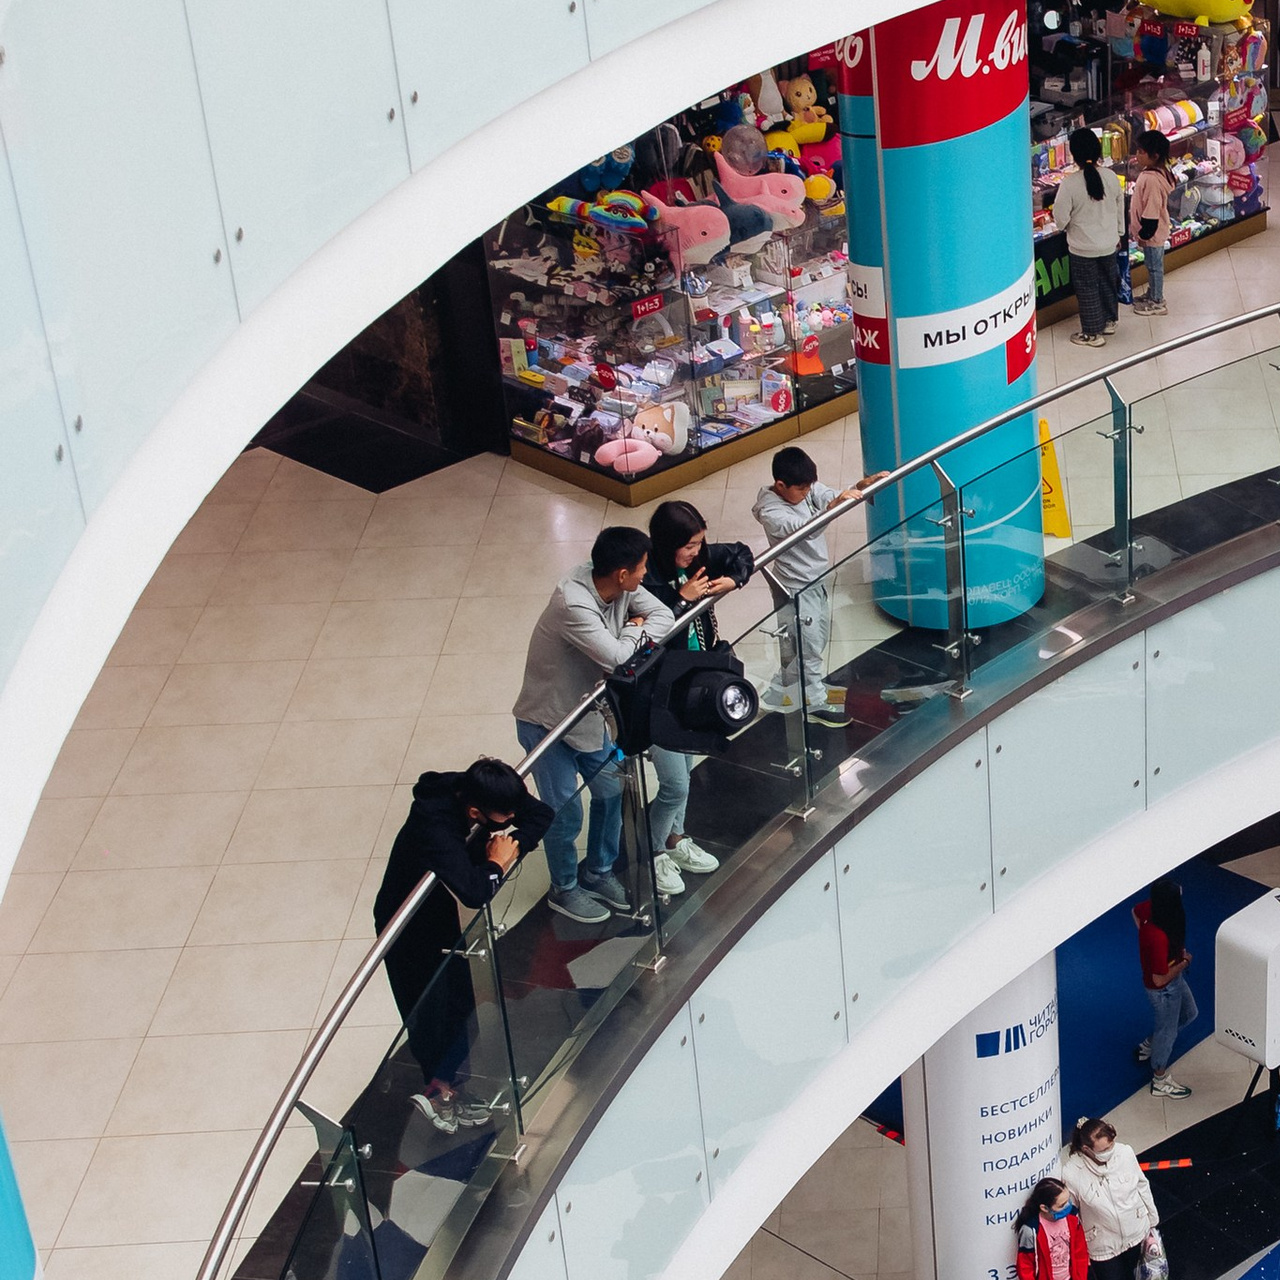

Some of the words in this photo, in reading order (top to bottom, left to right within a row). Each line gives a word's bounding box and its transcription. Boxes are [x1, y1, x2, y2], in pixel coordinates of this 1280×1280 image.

[1178, 25, 1197, 36] 1+1=3
[637, 298, 660, 314] 1+1=3
[923, 325, 966, 349] МЫ
[1029, 1010, 1058, 1044] ГОРО
[982, 1105, 1053, 1145] НОВИНКИ
[983, 1133, 1053, 1172] ПОДАРКИ
[986, 1208, 1020, 1226] КНИ
